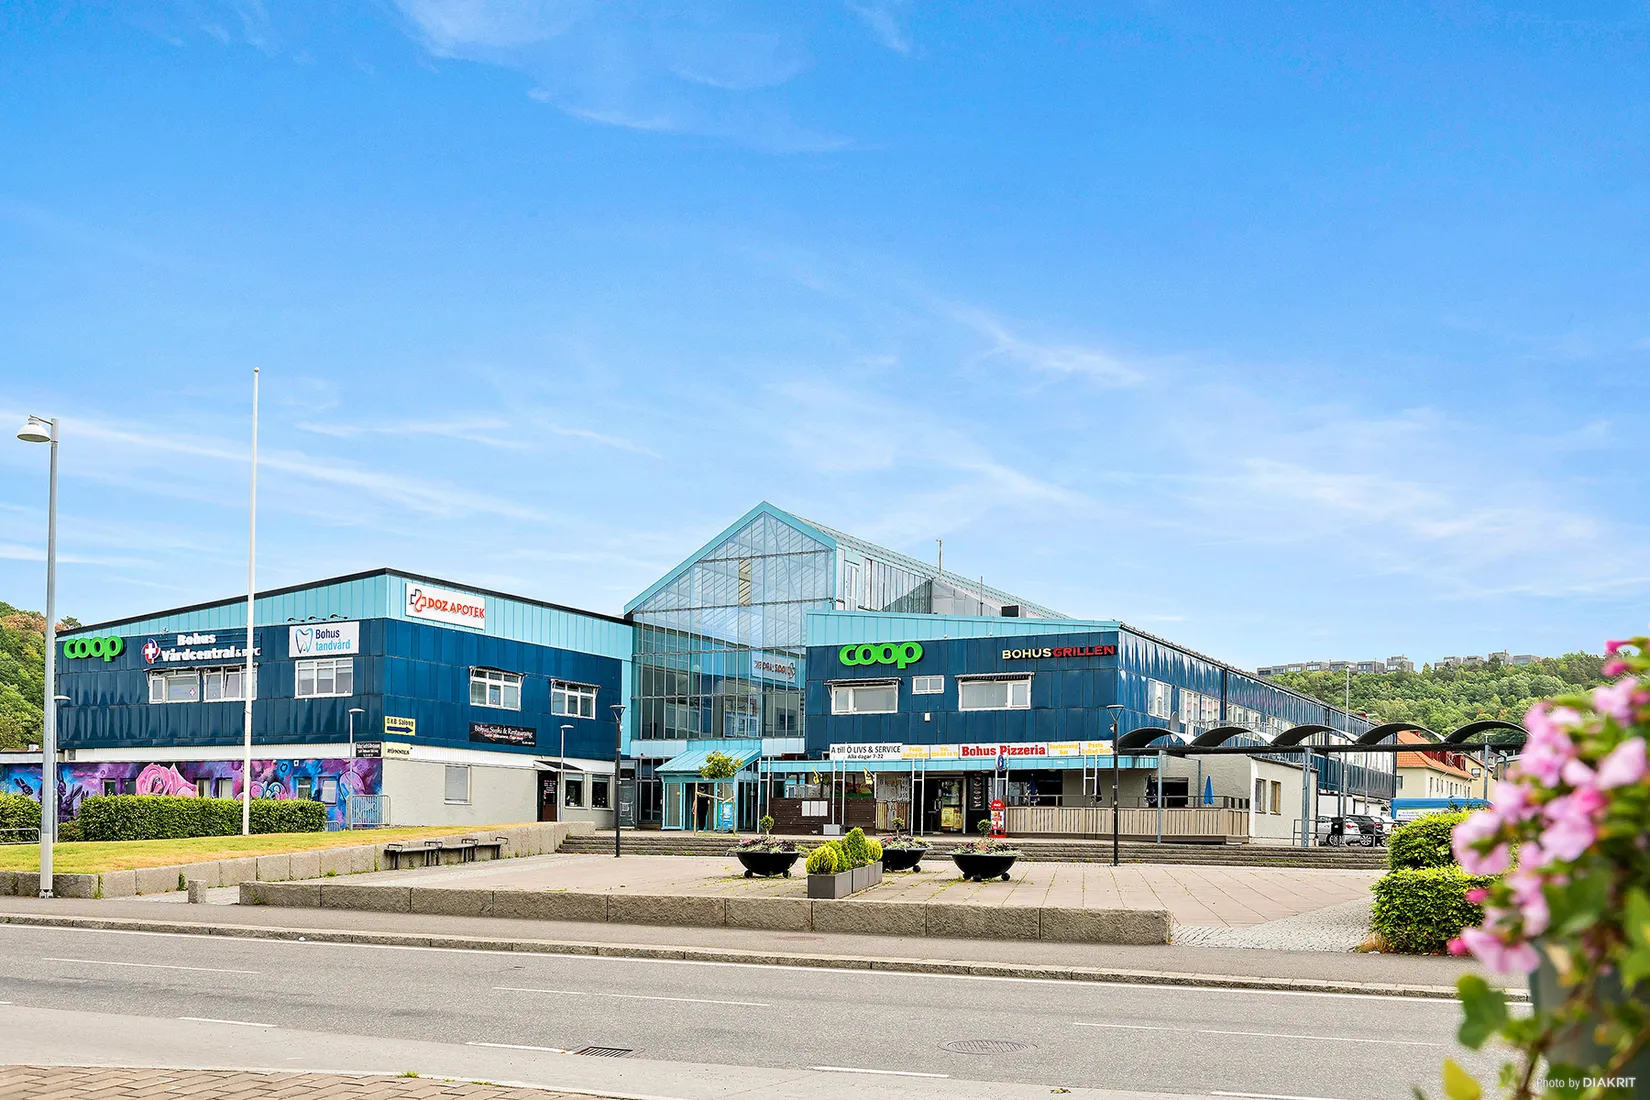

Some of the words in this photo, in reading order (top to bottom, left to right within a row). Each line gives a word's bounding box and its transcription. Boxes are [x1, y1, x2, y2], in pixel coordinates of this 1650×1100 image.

[428, 598, 448, 611] DOZ
[450, 602, 485, 619] APOTEK
[177, 633, 216, 646] Bohus
[316, 628, 340, 640] Bohus
[64, 636, 124, 662] coop
[316, 638, 350, 652] tandvård
[160, 645, 236, 662] Vårdcentral
[242, 647, 262, 657] BC
[839, 642, 924, 669] coop
[837, 746, 846, 754] till
[846, 745, 852, 754] Ö
[853, 746, 868, 754] LIVS
[868, 746, 873, 754] &
[874, 745, 900, 754] SERVICE
[962, 746, 996, 756] Bohus
[999, 744, 1046, 757] Pizzeria
